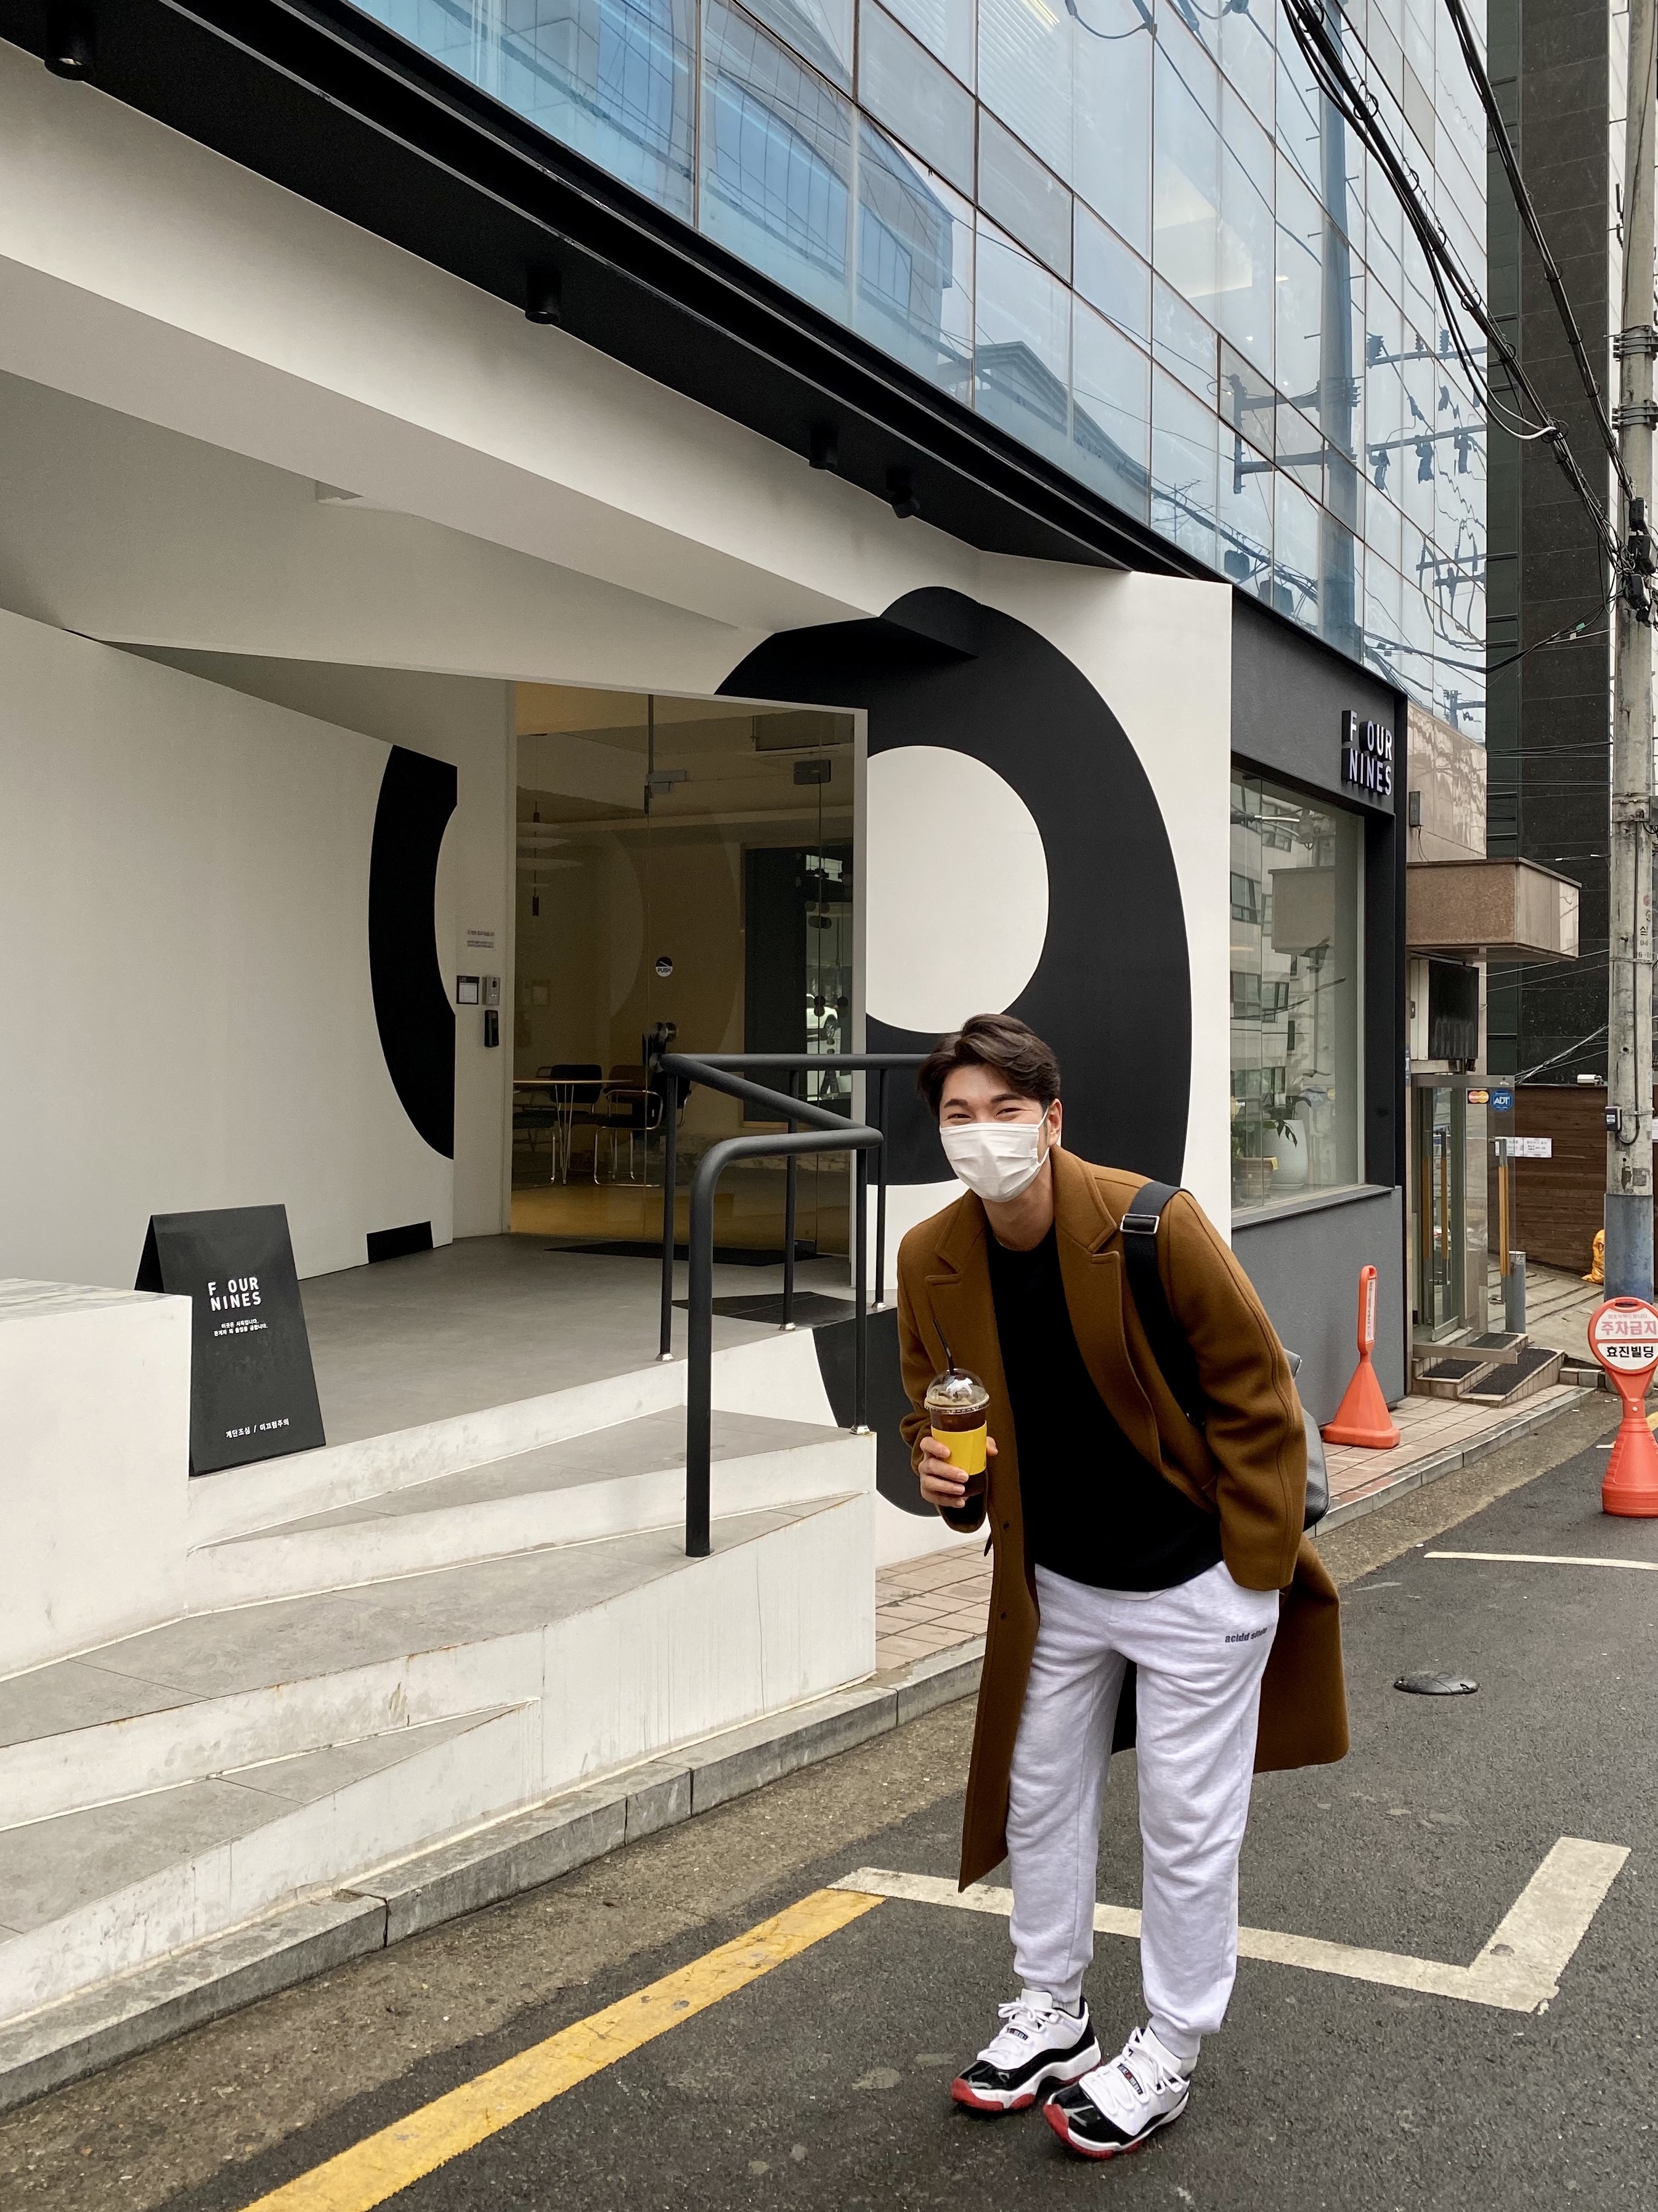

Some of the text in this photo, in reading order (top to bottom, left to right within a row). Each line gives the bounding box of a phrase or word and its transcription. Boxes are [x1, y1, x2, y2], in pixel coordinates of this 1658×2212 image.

[1349, 748, 1392, 796] NINES
[1493, 1096, 1510, 1105] ADT
[210, 1291, 262, 1311] NINES
[1601, 1320, 1657, 1336] 주차금지
[1606, 1346, 1654, 1358] 효진빌딩
[226, 1427, 251, 1438] 계단조심
[259, 1418, 290, 1431] 미끄럼주의
